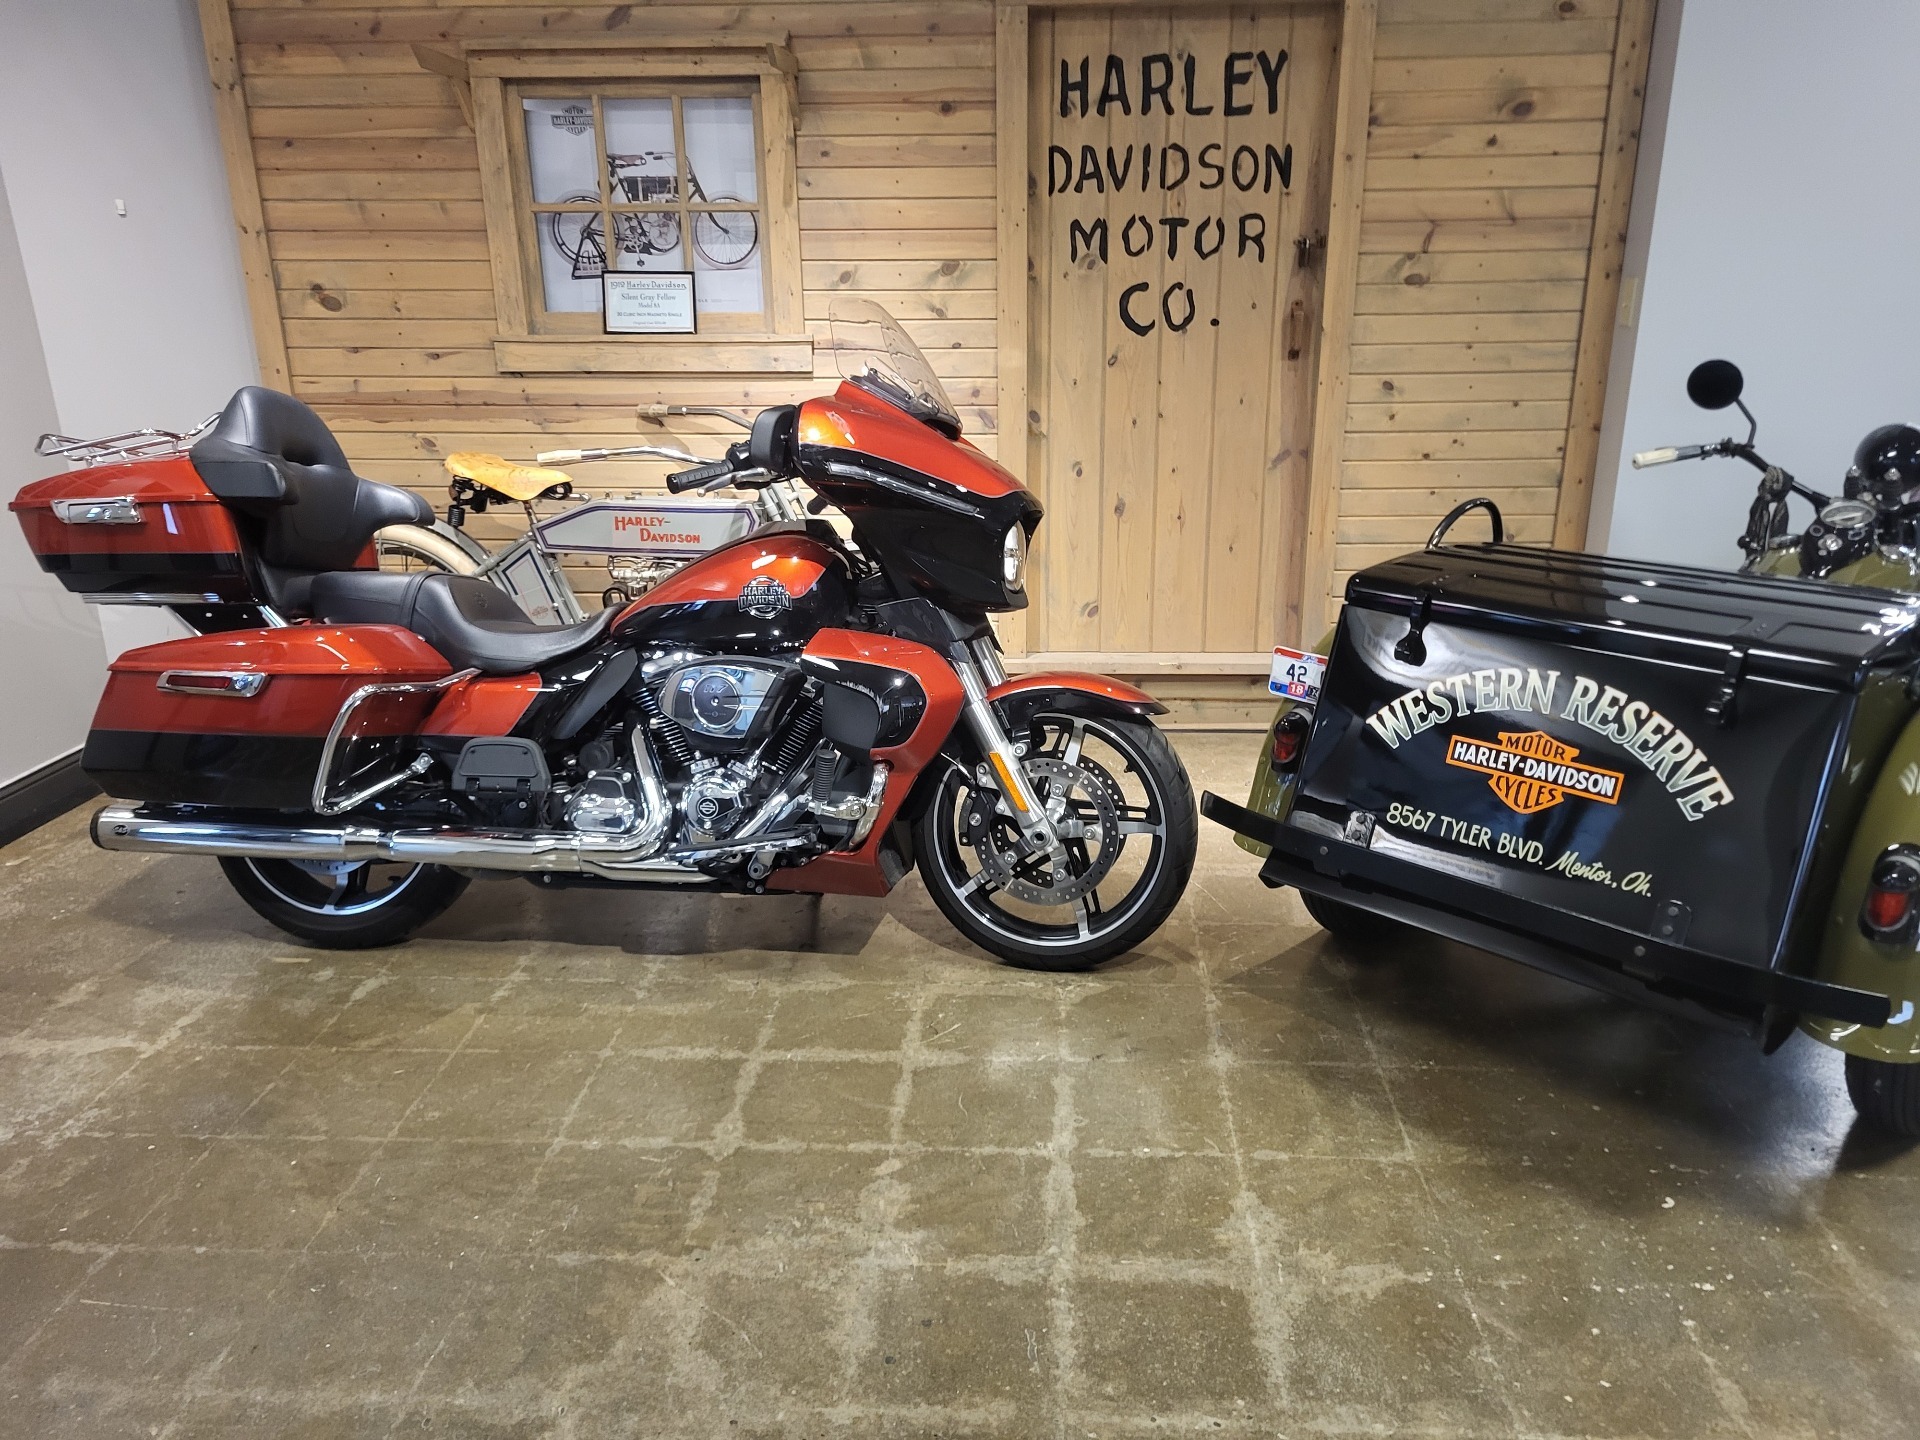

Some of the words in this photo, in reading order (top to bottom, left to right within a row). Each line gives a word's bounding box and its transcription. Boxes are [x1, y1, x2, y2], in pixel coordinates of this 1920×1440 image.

[1060, 49, 1288, 118] HARLEY
[1048, 143, 1292, 196] DAVIDSON
[1070, 213, 1265, 264] MOTOR
[640, 293, 654, 302] Gray
[1119, 282, 1220, 336] CO.
[614, 516, 671, 531] HARLEY-
[640, 528, 700, 543] DAVIDSON
[740, 595, 789, 608] DAVIDSON
[1290, 684, 1304, 695] 18
[1365, 668, 1560, 750] WESTERN
[1561, 675, 1734, 822] RESERVE
[1506, 734, 1565, 761] MOTOR
[1454, 742, 1616, 797] HARLEY-DAVIDSON
[1495, 775, 1558, 810] CYCLES
[1386, 802, 1435, 833] 8567
[1440, 816, 1490, 850] TYLER
[1496, 832, 1543, 866] BLVD.
[1545, 850, 1617, 888] Mentor,
[1621, 871, 1652, 897] Oh.
